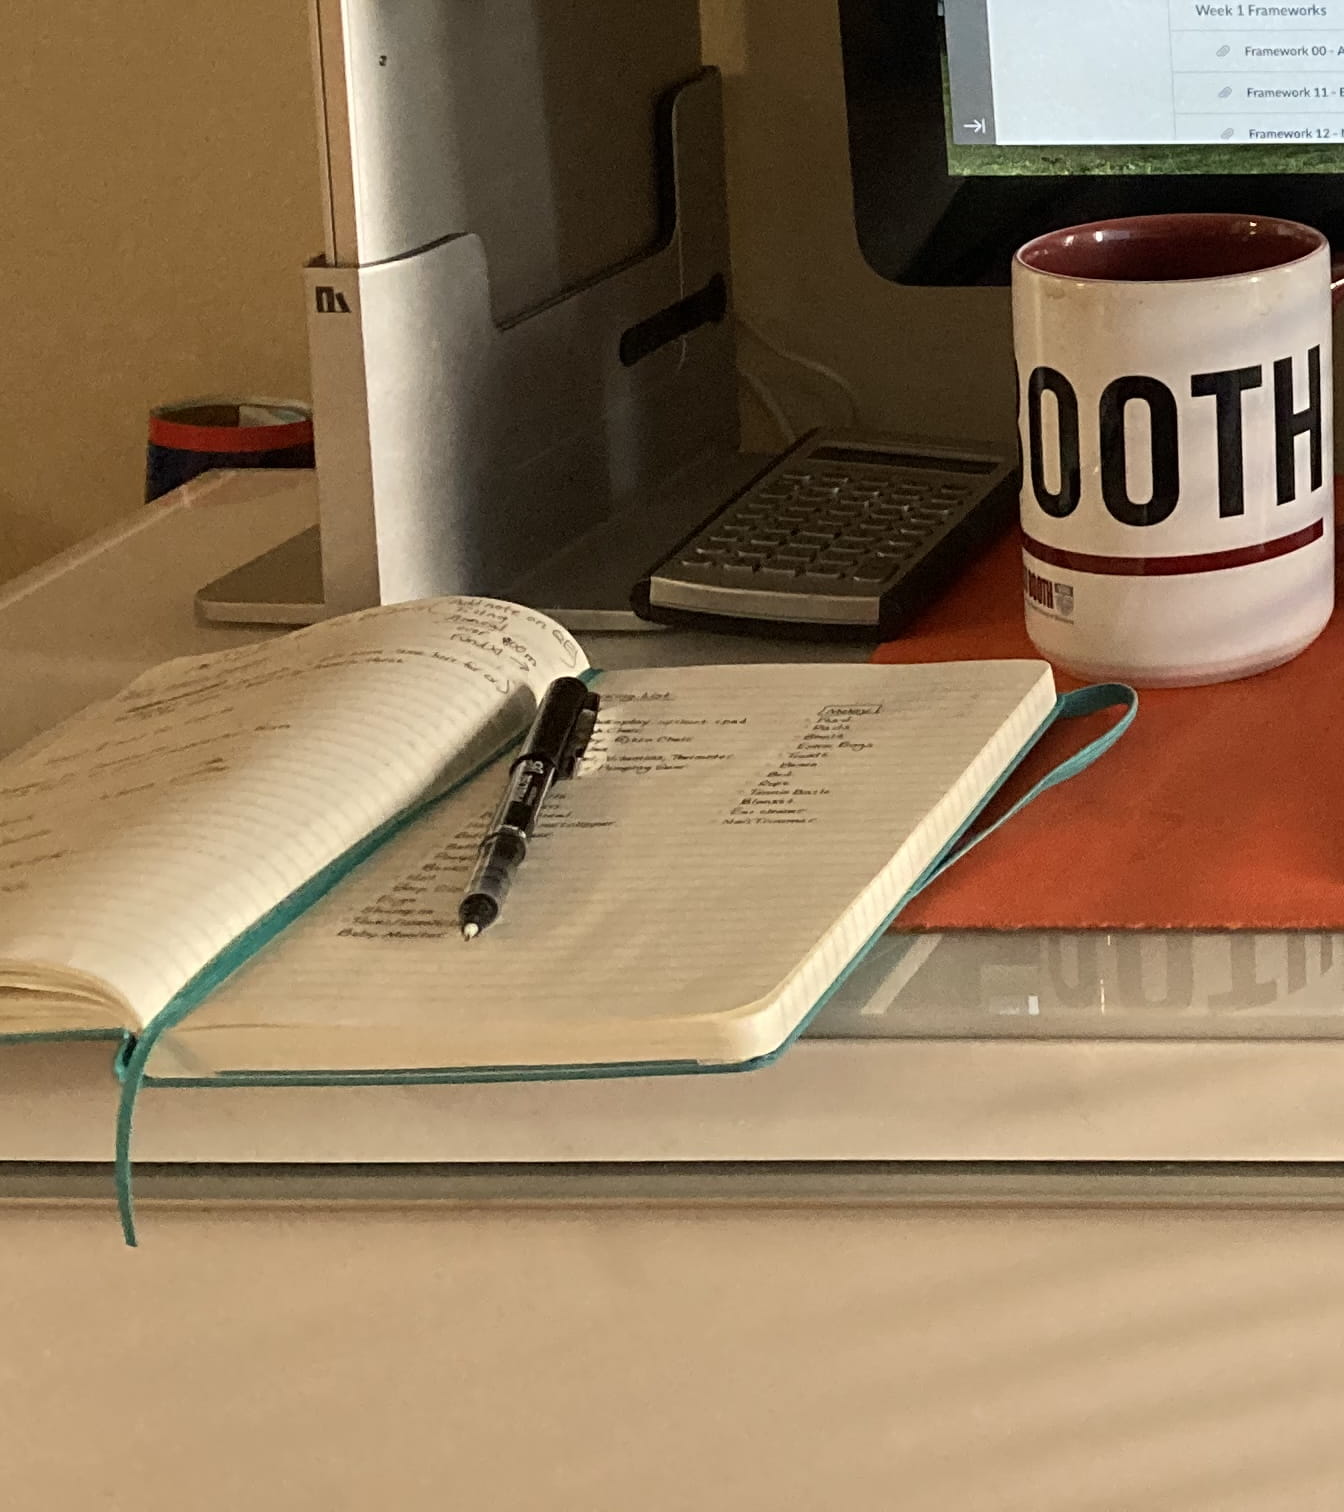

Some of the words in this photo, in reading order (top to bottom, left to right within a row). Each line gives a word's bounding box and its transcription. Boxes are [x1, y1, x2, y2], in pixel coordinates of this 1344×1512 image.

[1196, 5, 1232, 16] Week
[1238, 5, 1244, 16] 1
[1248, 4, 1326, 16] Frameworks
[1018, 344, 1323, 528] OOTH
